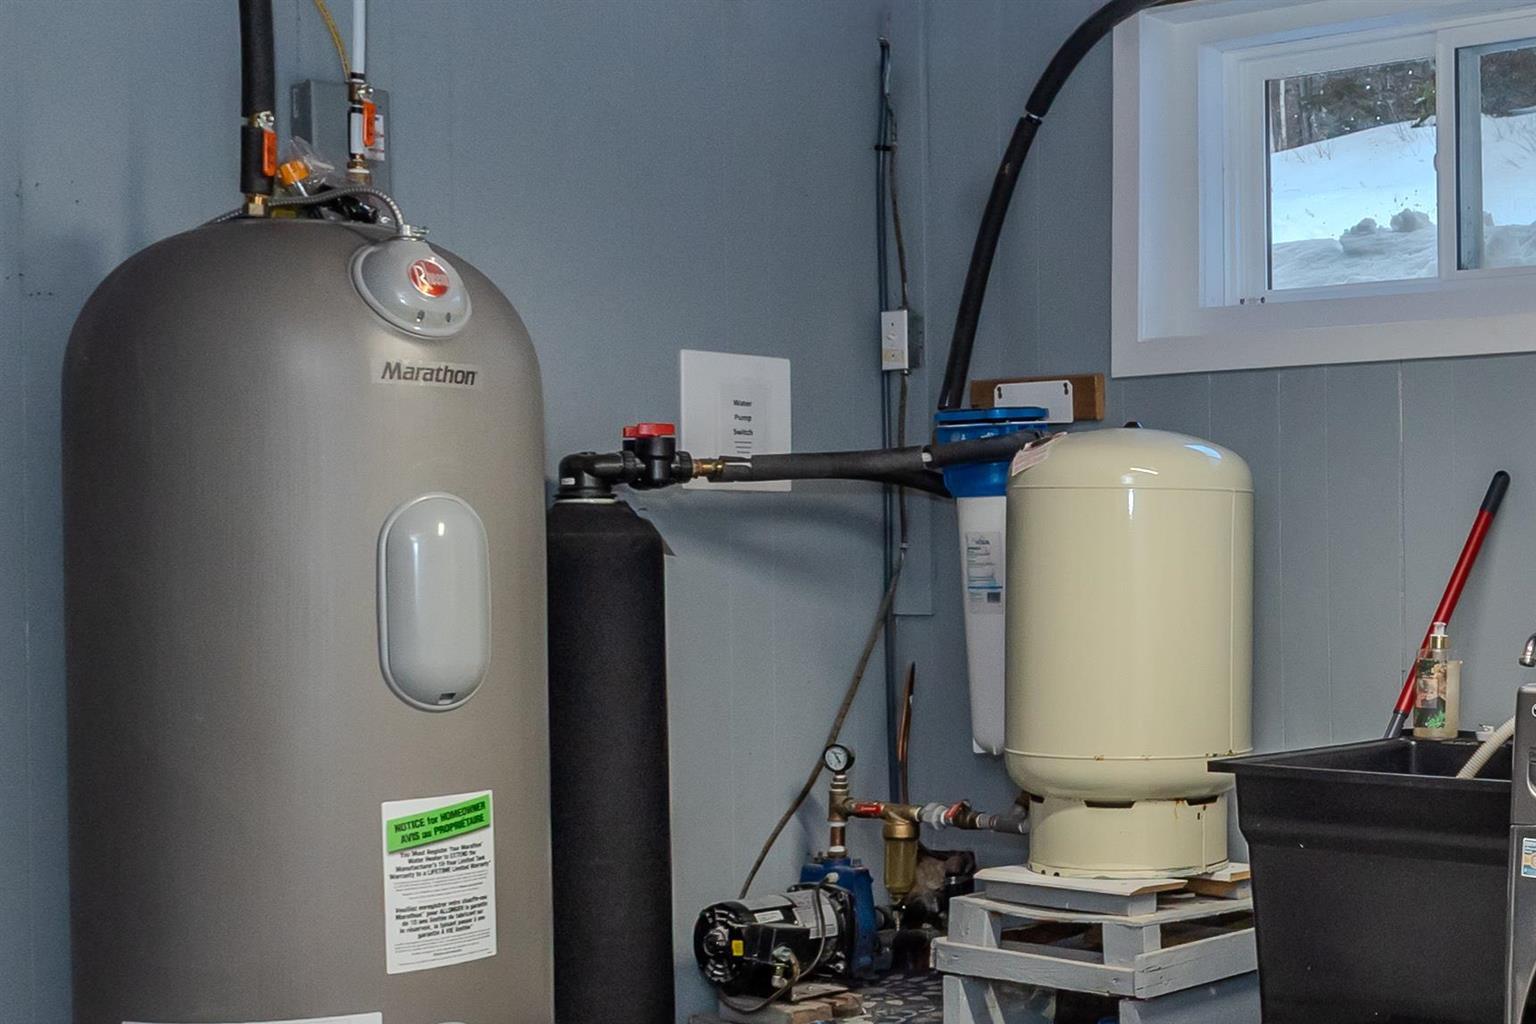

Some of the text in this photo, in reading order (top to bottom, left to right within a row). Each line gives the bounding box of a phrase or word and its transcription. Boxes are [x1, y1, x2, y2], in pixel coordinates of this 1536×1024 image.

[380, 361, 478, 386] Marathon
[394, 817, 426, 833] NOTICE
[400, 831, 421, 844] AVIS
